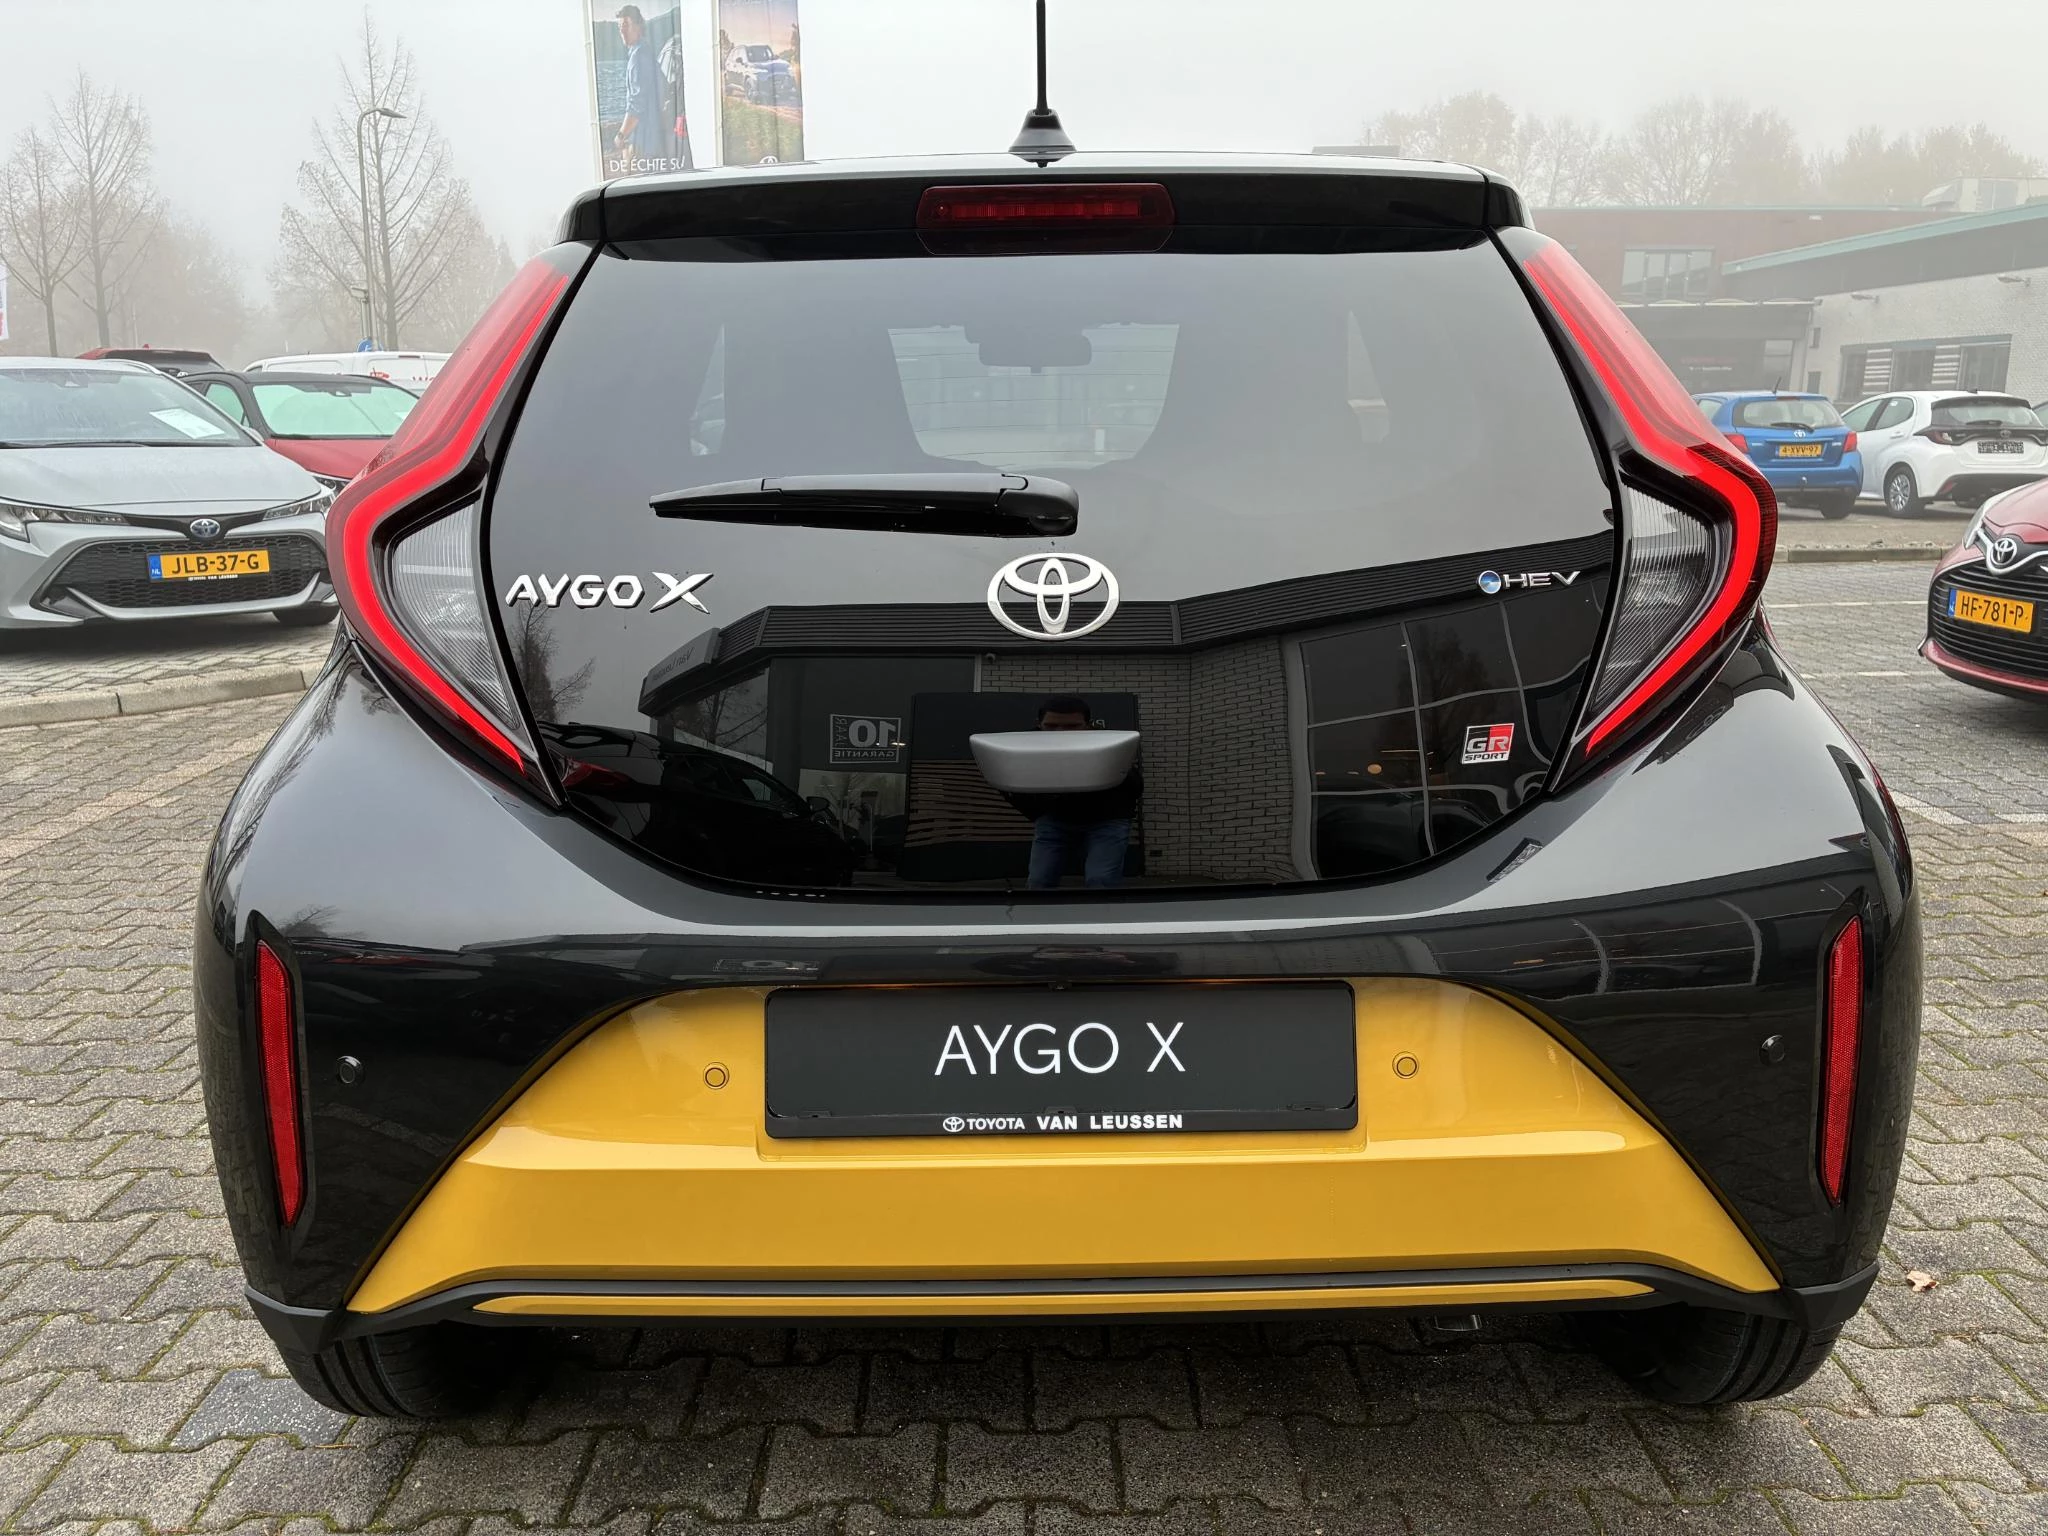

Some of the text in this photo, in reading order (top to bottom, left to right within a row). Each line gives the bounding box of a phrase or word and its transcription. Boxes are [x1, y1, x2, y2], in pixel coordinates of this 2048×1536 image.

[609, 160, 628, 172] DE
[171, 553, 260, 575] JLB-37-G
[1502, 570, 1581, 589] HEV
[505, 571, 715, 614] AYGO X
[1960, 595, 2025, 626] HF-781-P
[1467, 736, 1509, 753] GR
[1464, 752, 1507, 762] SPORT
[934, 1021, 1186, 1076] AYGO X
[967, 1114, 1183, 1131] TOYOTA VAN LEUSSEN
